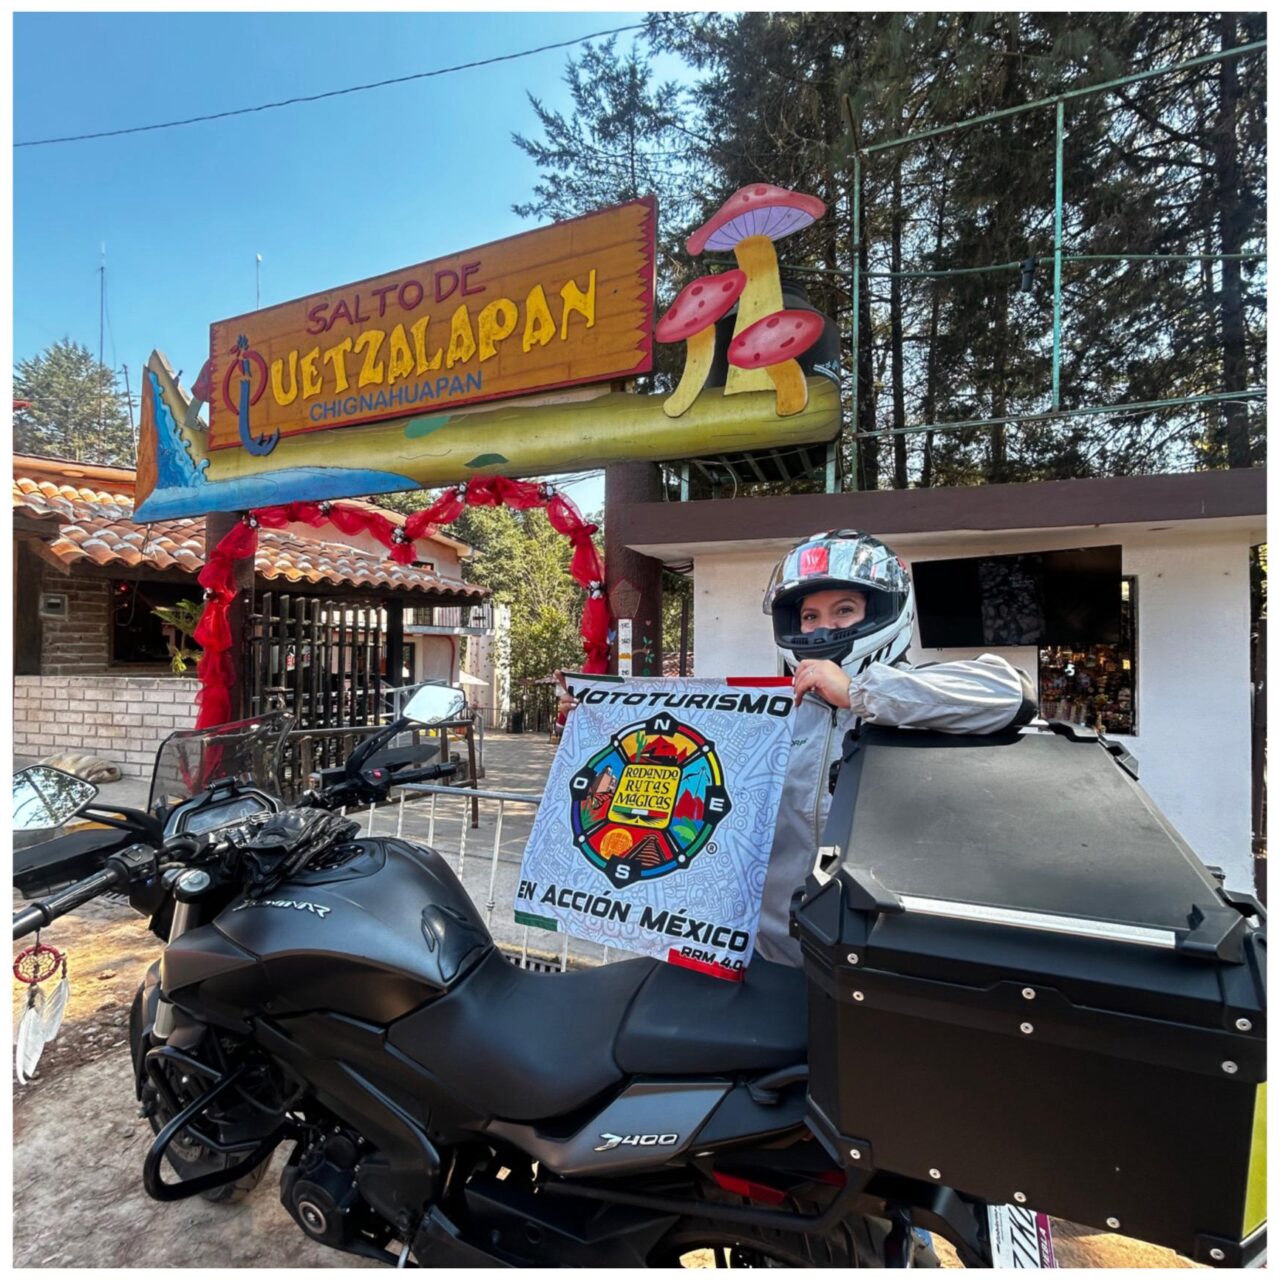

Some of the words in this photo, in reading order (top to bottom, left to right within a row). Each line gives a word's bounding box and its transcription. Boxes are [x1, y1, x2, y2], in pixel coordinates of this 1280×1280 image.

[305, 278, 424, 336] SALTO
[434, 261, 487, 300] DE
[308, 369, 483, 423] CHIGNAHUAPAN
[567, 685, 794, 718] MOTOTURISMO
[654, 718, 670, 730] N
[709, 797, 724, 812] E
[615, 864, 631, 879] S
[517, 880, 537, 901] EN
[540, 884, 632, 923] ACCIÓN
[639, 906, 750, 953] MÉXICO
[681, 946, 717, 964] RRM
